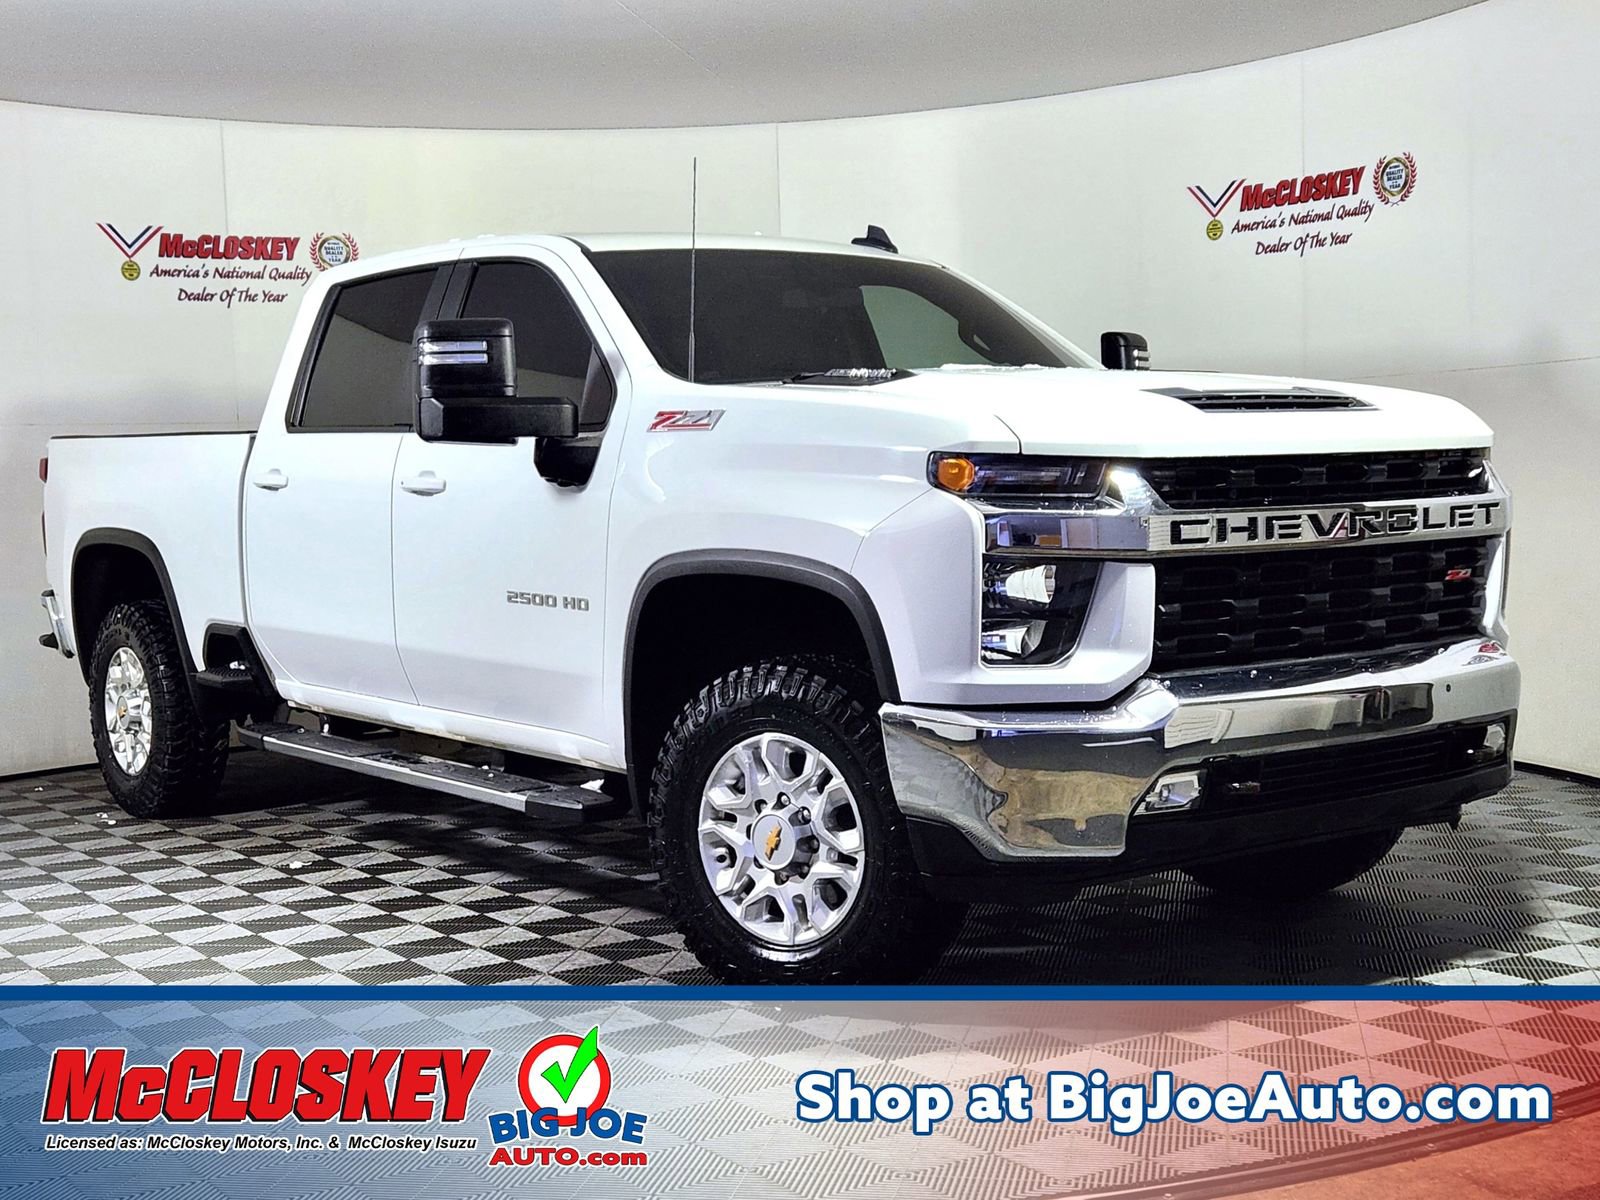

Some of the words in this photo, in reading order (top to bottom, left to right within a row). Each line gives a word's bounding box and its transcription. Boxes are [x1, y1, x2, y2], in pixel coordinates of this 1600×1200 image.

[1240, 166, 1366, 212] McCLOSKEY
[1231, 212, 1286, 234] America's
[1288, 208, 1334, 227] National
[1336, 199, 1374, 222] Quality
[158, 233, 300, 261] McCLOSKEY
[1255, 237, 1292, 255] Dealer
[1294, 233, 1309, 257] Of
[1309, 234, 1328, 249] The
[1329, 232, 1353, 247] Year
[149, 264, 209, 280] America's
[213, 264, 267, 280] National
[268, 265, 312, 287] Quality
[177, 286, 217, 303] Dealer
[219, 289, 237, 309] Of
[237, 290, 260, 304] The
[261, 290, 288, 304] Year
[1170, 502, 1501, 546] CHEVROLET
[506, 590, 558, 608] 2500
[562, 596, 590, 612] HD
